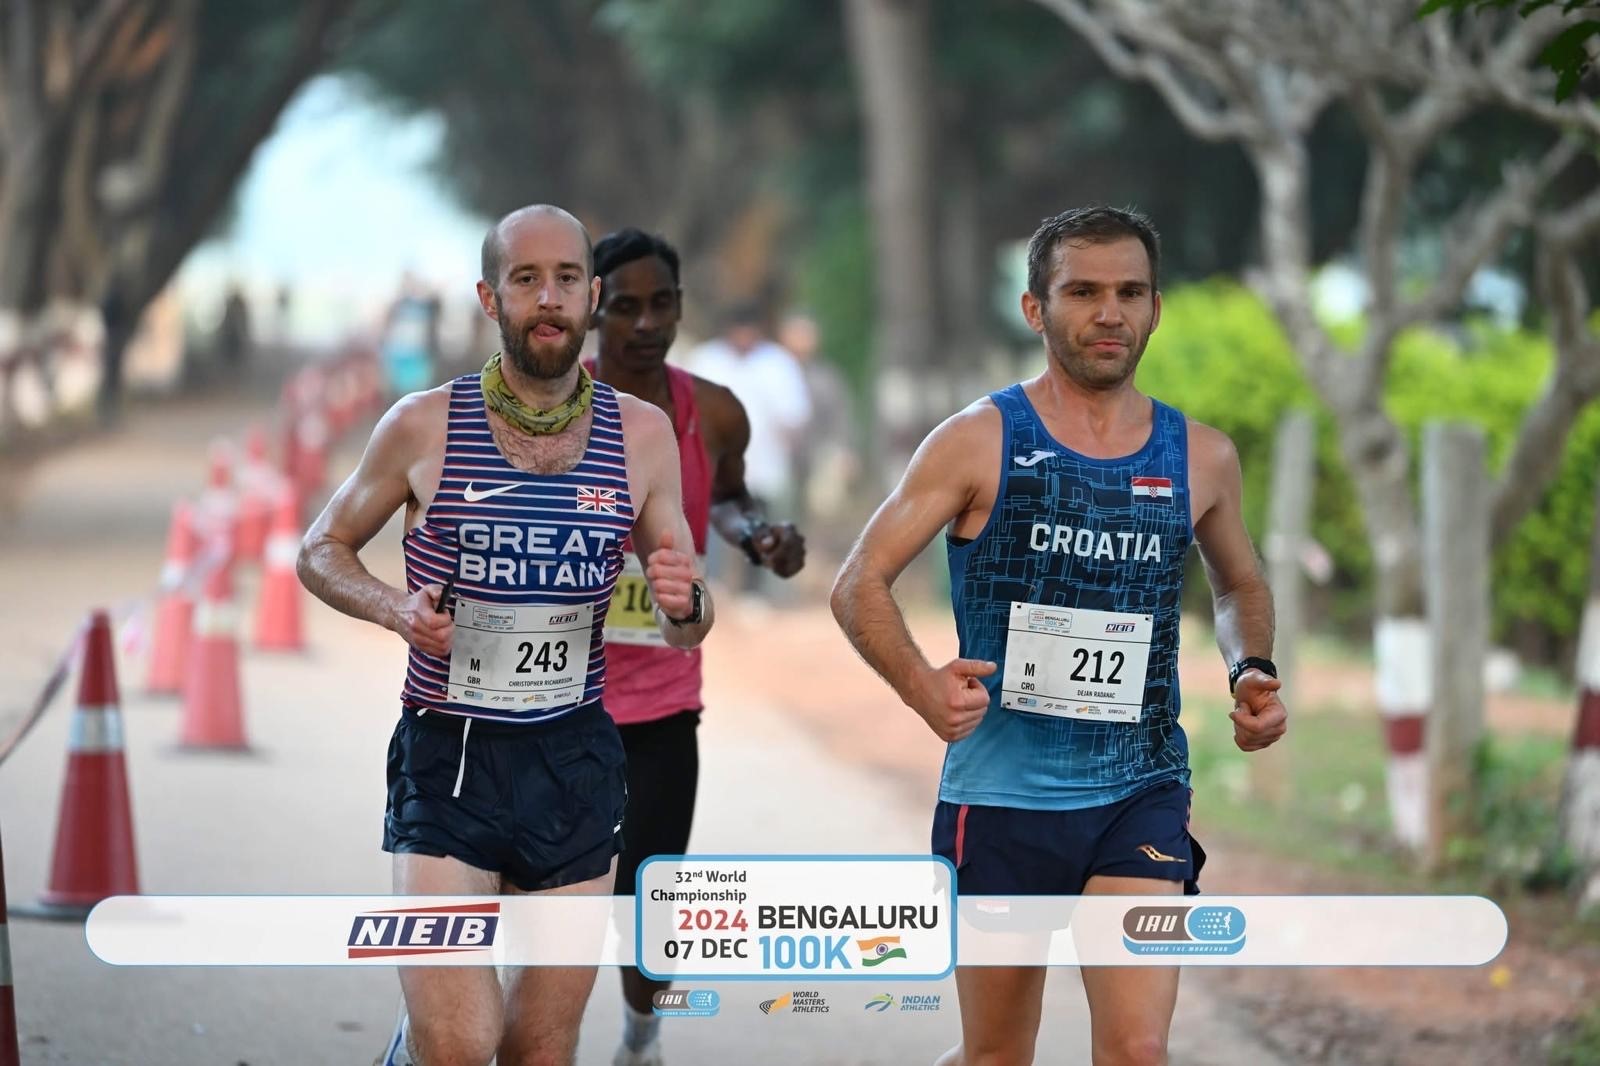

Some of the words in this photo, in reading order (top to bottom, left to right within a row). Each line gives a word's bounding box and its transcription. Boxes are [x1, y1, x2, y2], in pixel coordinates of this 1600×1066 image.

[458, 523, 616, 557] GREAT
[1030, 523, 1161, 563] CROATIA
[459, 553, 607, 587] BRITAIN
[515, 640, 569, 674] 243
[470, 658, 480, 672] M
[1024, 662, 1036, 677] M
[1070, 648, 1125, 685] 212
[467, 675, 481, 685] GBR
[508, 680, 543, 688] CHRISTOPHER
[544, 676, 573, 686] RICHARDSON
[1021, 682, 1035, 691] CRO
[1077, 689, 1093, 697] DEJAN
[1094, 691, 1116, 699] RADANAC
